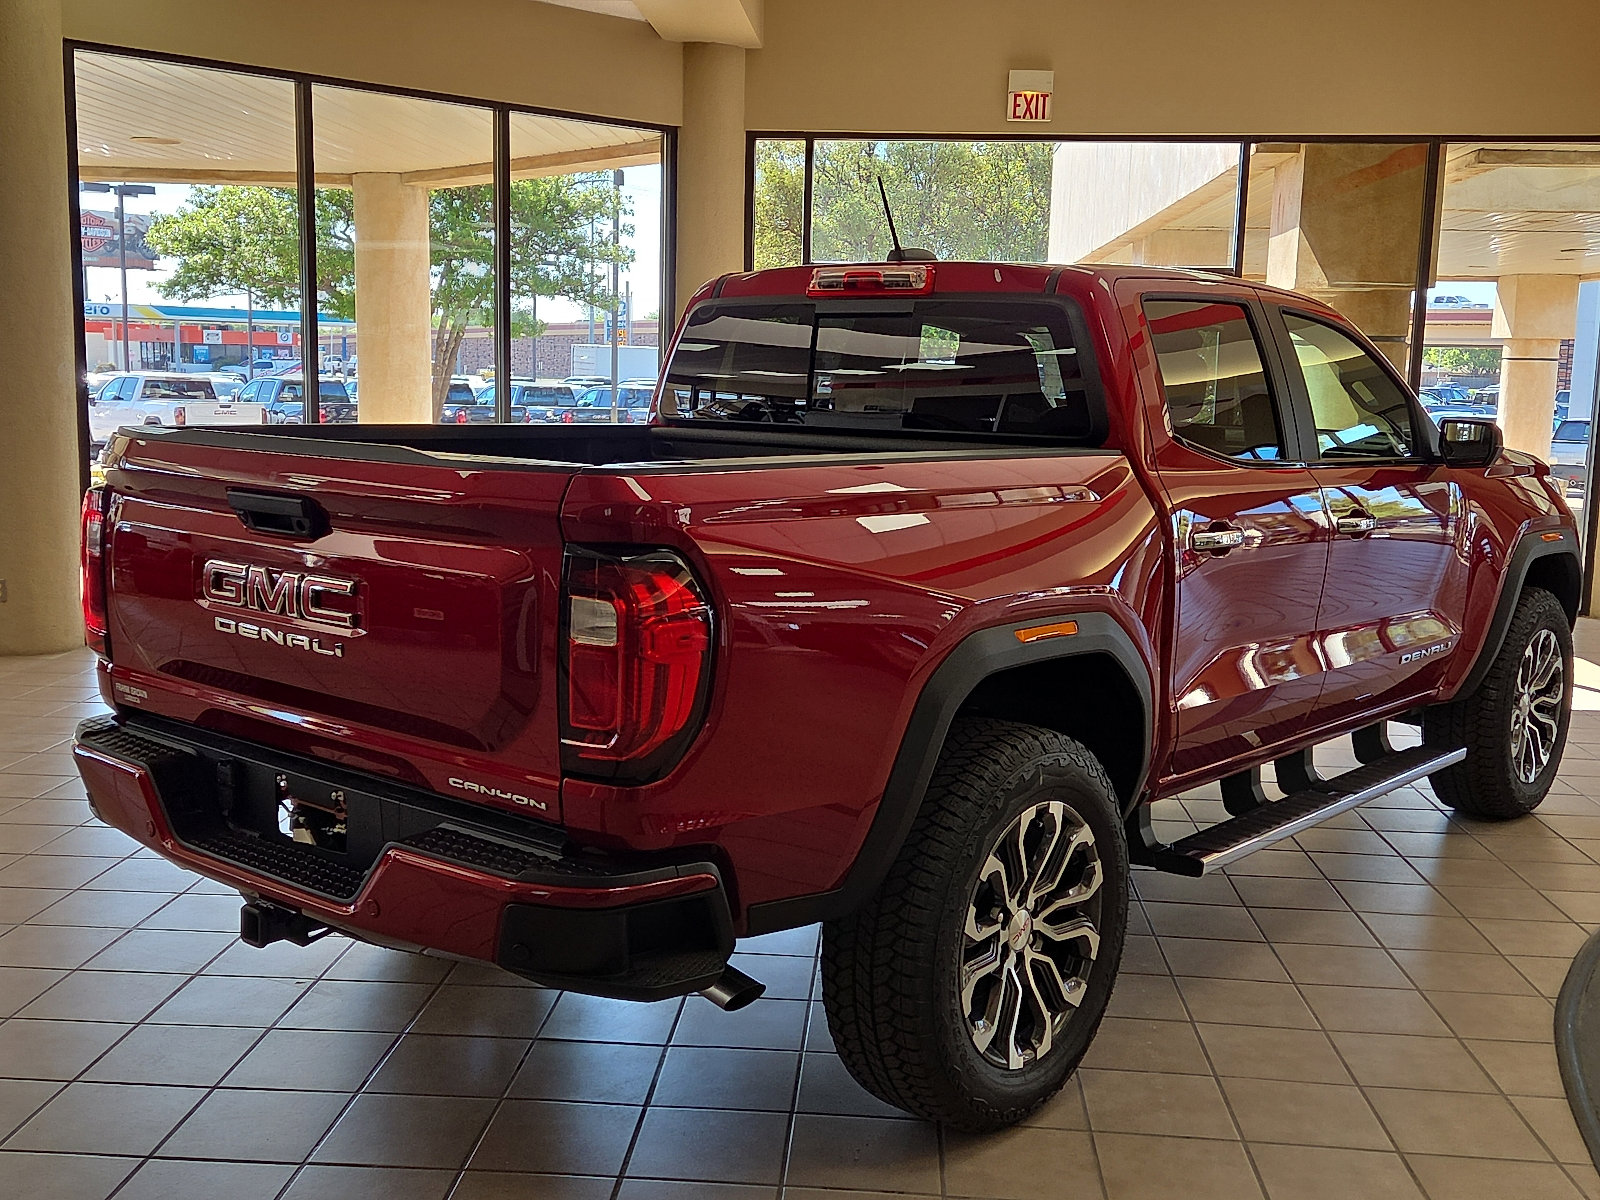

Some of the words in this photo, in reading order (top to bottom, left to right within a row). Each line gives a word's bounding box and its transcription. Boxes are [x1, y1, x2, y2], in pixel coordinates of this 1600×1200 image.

[1012, 93, 1050, 120] EXIT
[203, 559, 354, 627] GMC
[214, 616, 343, 657] DENALI
[1400, 641, 1452, 665] DENALI
[448, 777, 547, 811] CANYON
[1012, 917, 1030, 945] GMC
